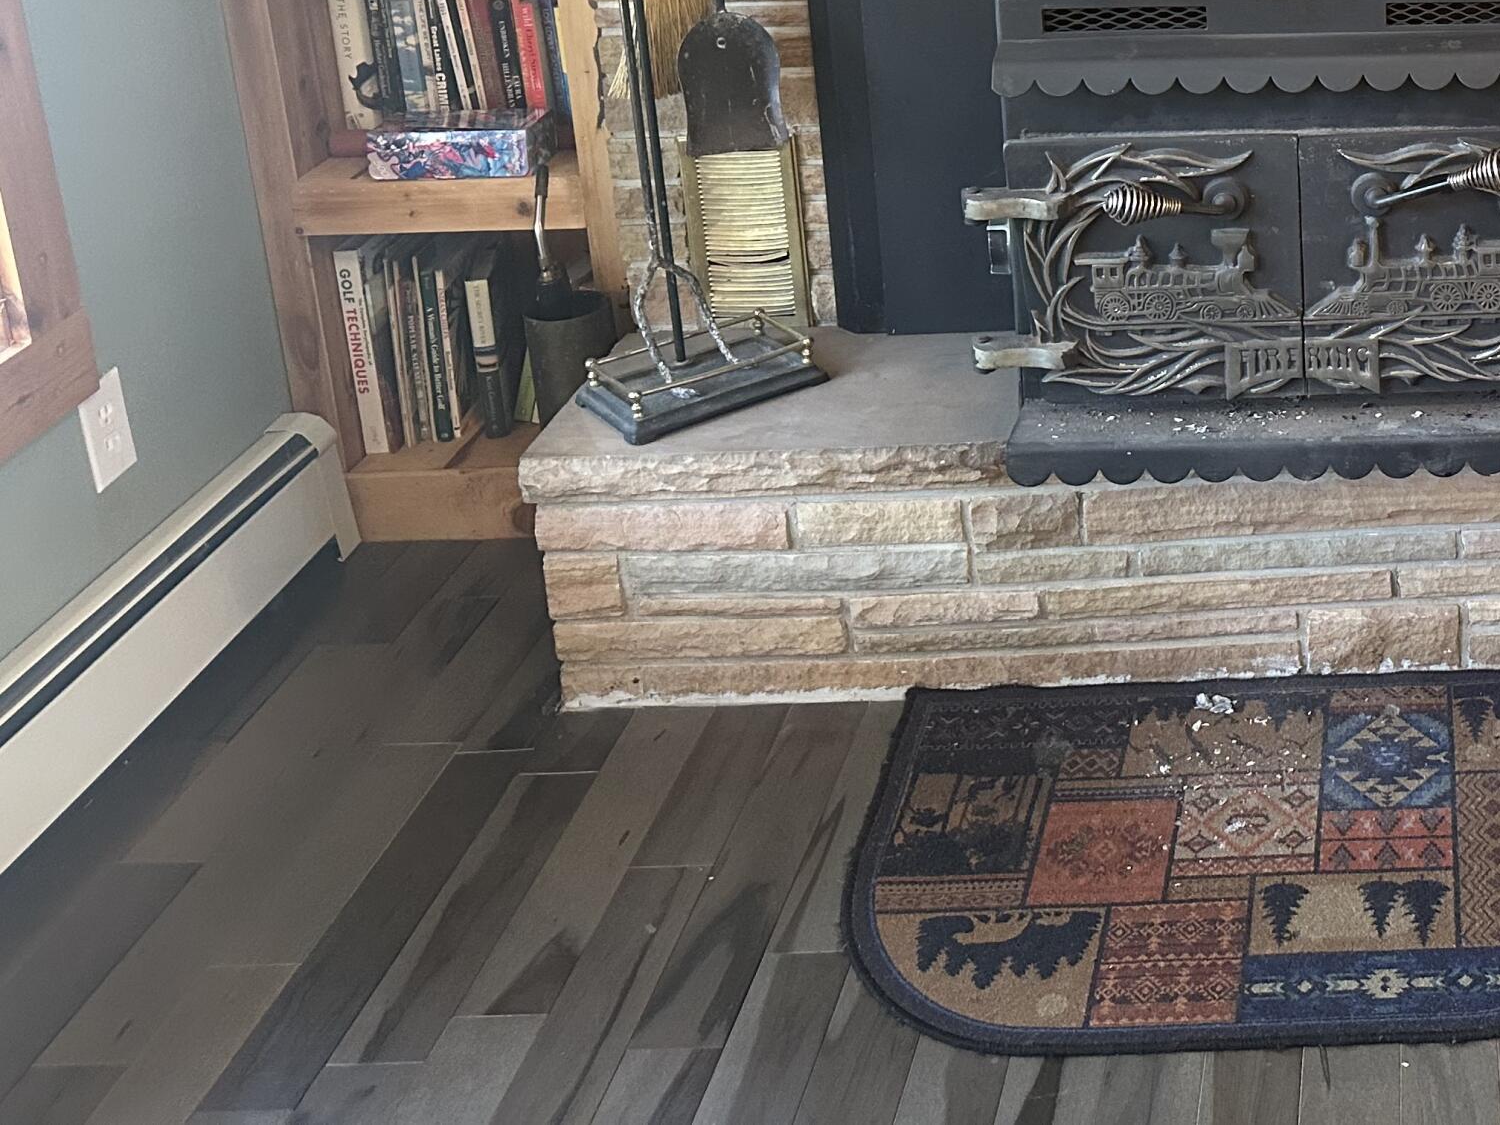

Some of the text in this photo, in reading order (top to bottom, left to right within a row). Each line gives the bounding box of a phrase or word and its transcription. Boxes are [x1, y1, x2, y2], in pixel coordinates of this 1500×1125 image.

[339, 24, 353, 61] STORY
[430, 26, 440, 48] Great
[498, 20, 511, 58] UNBROKEN
[434, 49, 443, 71] Lakes
[501, 62, 516, 108] HILLENBRAN
[340, 269, 370, 394] GOLF TECHNIQUES
[426, 314, 438, 343] Woman's
[430, 344, 440, 364] Guide
[433, 373, 444, 394] Better
[435, 394, 446, 411] Golf
